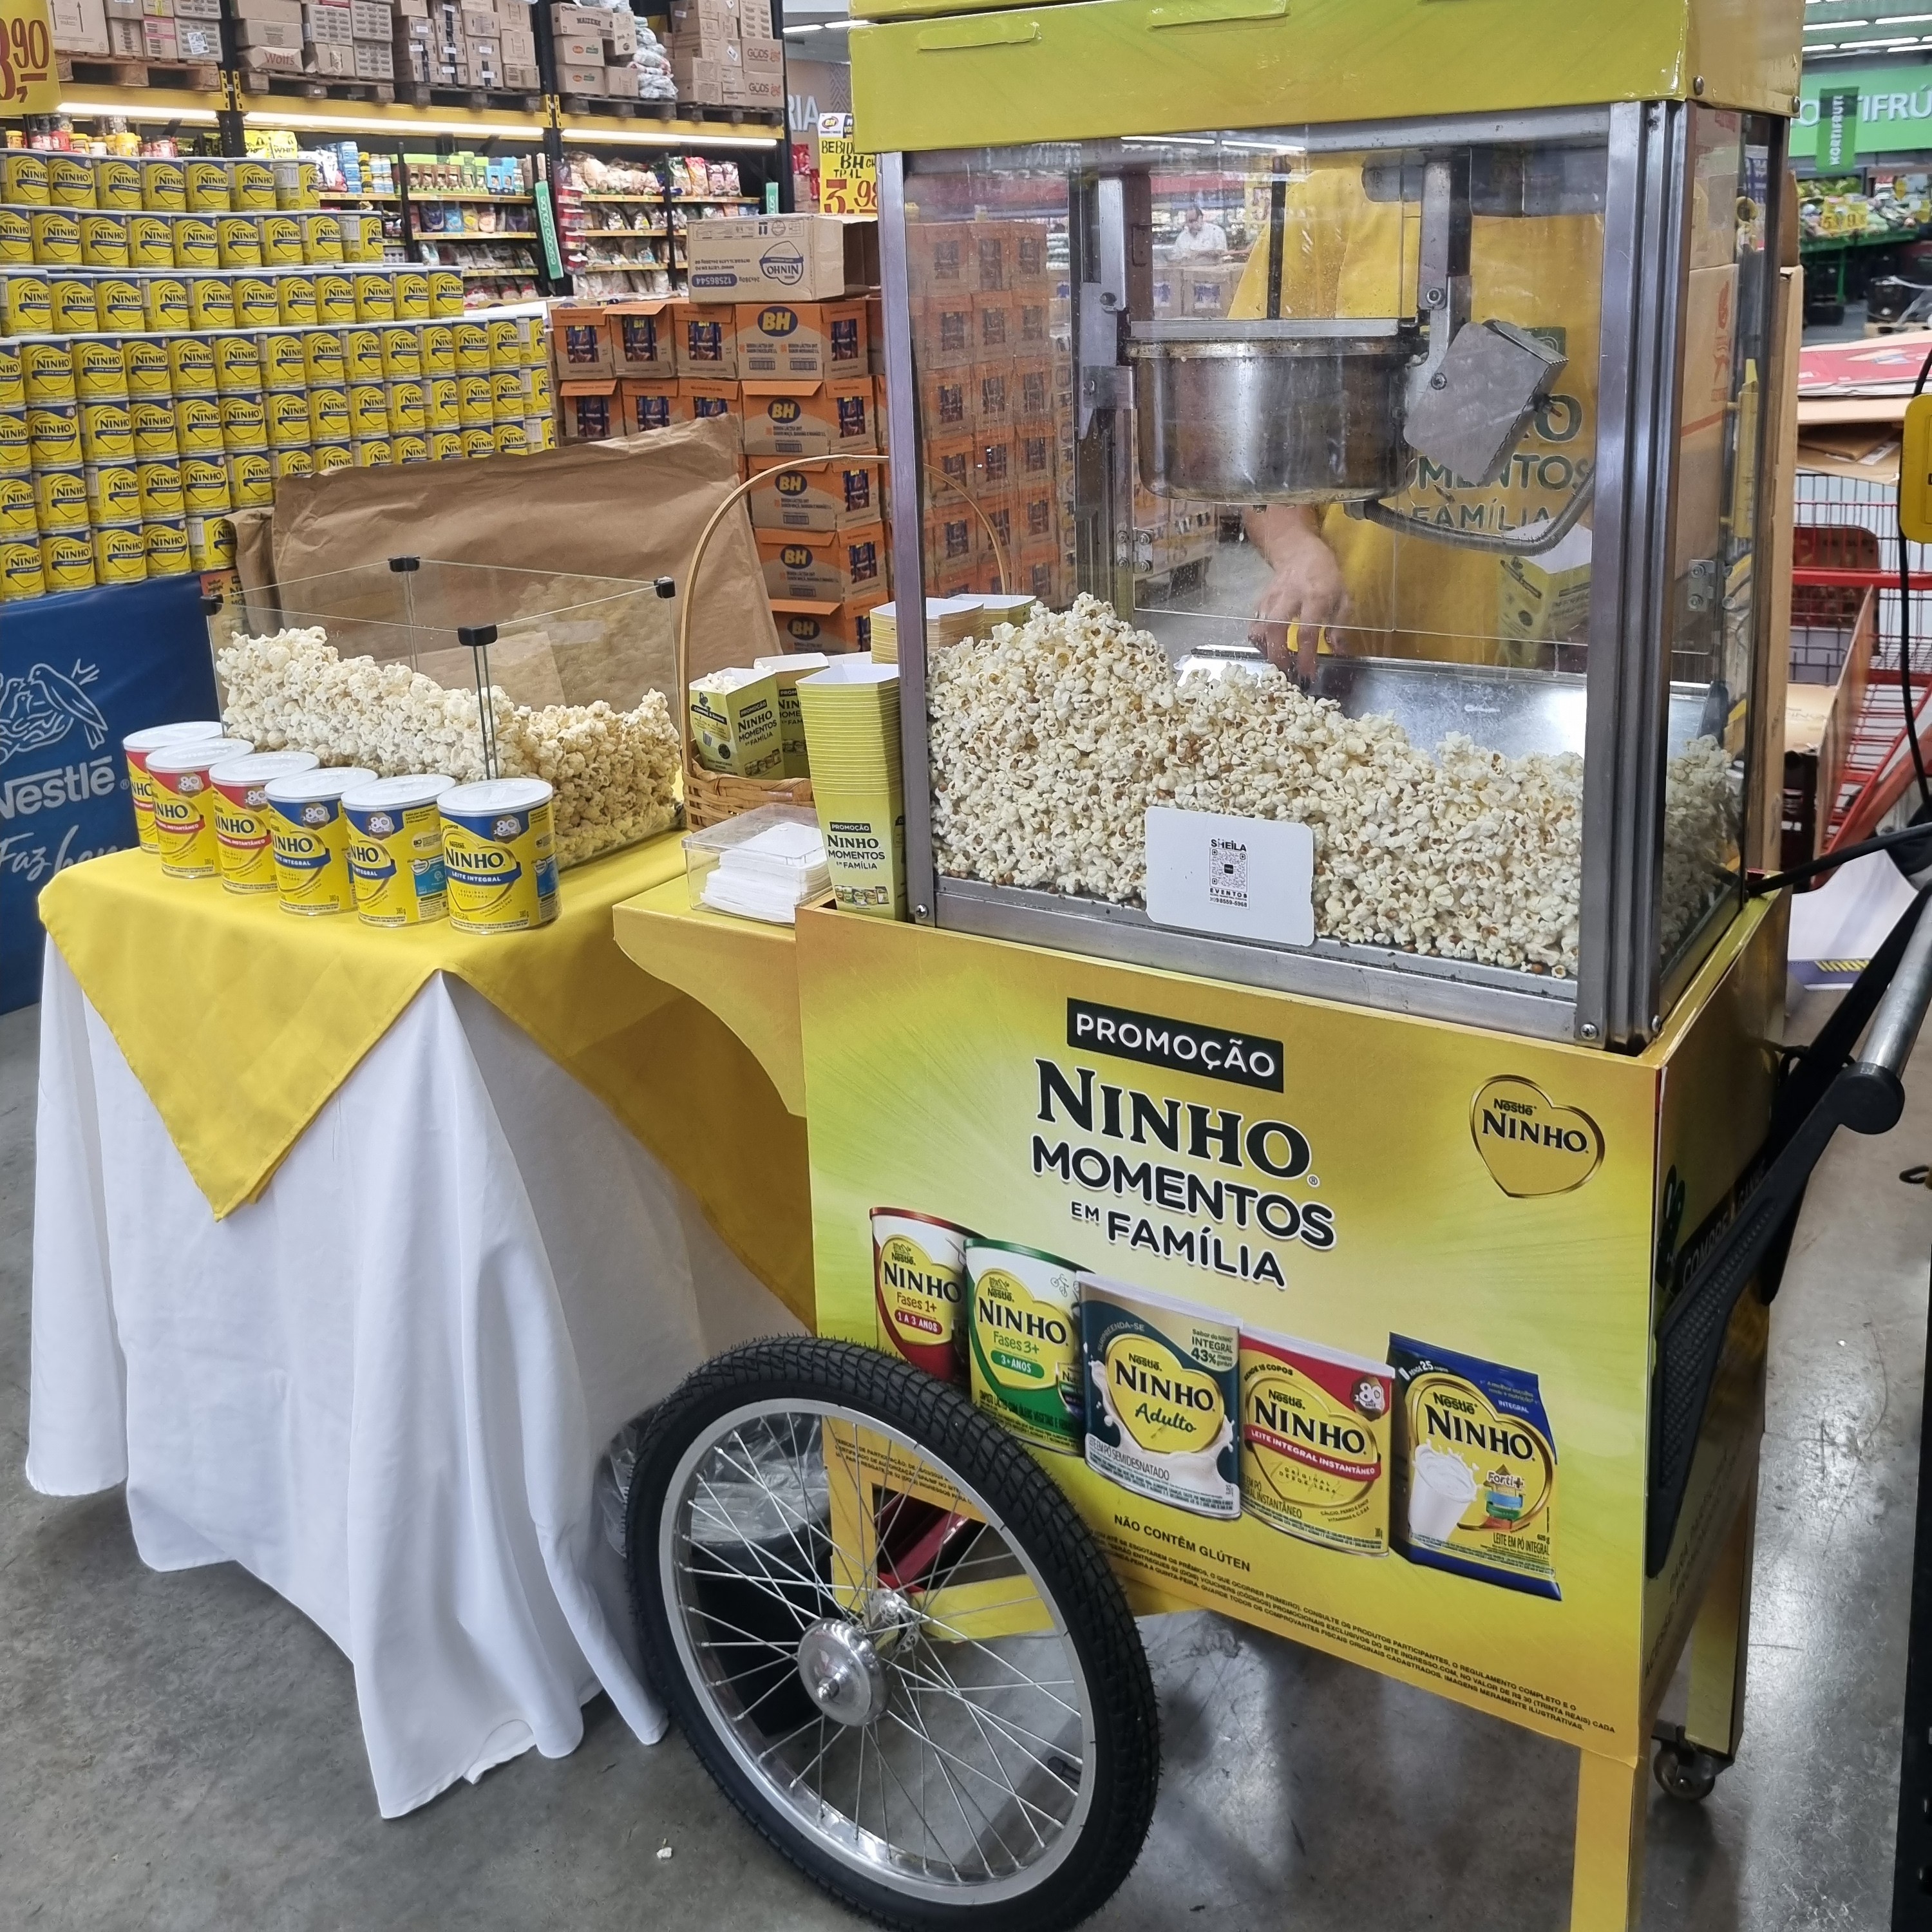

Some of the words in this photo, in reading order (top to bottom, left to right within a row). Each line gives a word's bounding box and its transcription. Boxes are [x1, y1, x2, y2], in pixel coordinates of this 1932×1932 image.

[822, 140, 855, 154] BEBID
[840, 155, 864, 169] BH
[57, 172, 89, 182] NINHO
[48, 227, 78, 236] NINHO
[95, 230, 126, 240] NINHO
[188, 231, 216, 241] NINHO
[767, 265, 799, 274] NINHO
[111, 294, 140, 303] NINHO
[247, 291, 276, 300] NINHO
[762, 312, 791, 330] BH
[463, 336, 487, 345] NINHO
[87, 357, 120, 366] NINHO
[136, 355, 166, 365] NINHO
[184, 352, 212, 362] NINHO
[229, 350, 257, 359] NINHO
[36, 359, 70, 369] NINHO
[228, 410, 260, 419] NINHO
[772, 403, 795, 418] BH
[35, 424, 71, 433] NINHO
[139, 417, 171, 426] NINHO
[151, 477, 179, 486] NINHO
[190, 473, 222, 482] NINHO
[779, 476, 801, 491] BH
[112, 543, 142, 552] NINHO
[150, 537, 184, 547] NINHO
[10, 557, 41, 567] NINHO
[56, 551, 89, 560] NINHO
[784, 549, 807, 565] BH
[793, 621, 814, 636] BH
[737, 710, 772, 732] NINHO
[739, 720, 777, 742] MOMENTOS
[750, 732, 773, 745] FAMÍLIA
[154, 802, 189, 819] INHO
[827, 835, 879, 849] NINHO
[283, 858, 311, 866] INTEGRAL
[445, 847, 504, 869] NINHO
[828, 850, 886, 860] MOMENTOS
[844, 861, 878, 869] FAMÍLIA
[452, 871, 466, 880] LEITE
[1077, 1013, 1274, 1077] PROMOÇÃO
[1493, 1098, 1533, 1115] Nestlé
[1035, 1059, 1311, 1179] NINHO
[1482, 1109, 1587, 1152] NINHO
[1032, 1136, 1334, 1247] MOMENTOS
[1072, 1202, 1099, 1222] EM
[1108, 1211, 1286, 1287] FAMÍLIA
[891, 1253, 914, 1265] Nestlé
[884, 1260, 962, 1303] NINHO
[896, 1292, 922, 1310] Fases
[925, 1301, 937, 1312] 1+
[987, 1287, 1013, 1302] Nestlé
[904, 1314, 909, 1323] A
[911, 1316, 916, 1325] 3
[918, 1318, 938, 1332] ANOS
[979, 1296, 1066, 1345] NINHO
[1097, 1321, 1145, 1352] SURPREENDA-SE
[1192, 1329, 1209, 1338] Sabor
[994, 1331, 1022, 1352] Fases
[1023, 1340, 1039, 1354] 3+
[1191, 1336, 1233, 1353] INTEGRAL
[1128, 1352, 1160, 1370] Nestlé
[1191, 1347, 1217, 1365] 43%
[1012, 1356, 1032, 1373] ANOS
[1266, 1363, 1293, 1376] COPOS
[1420, 1361, 1434, 1371] 25
[1115, 1358, 1214, 1411] NINHO
[1268, 1388, 1303, 1408] Nestlé
[1433, 1392, 1475, 1415] Nestlé
[1498, 1399, 1530, 1414] INTEGRAL
[1135, 1403, 1197, 1433] Adulto
[1254, 1395, 1365, 1454] NINHO
[1425, 1403, 1533, 1460] NINHO
[1251, 1430, 1271, 1443] LEITE
[1273, 1435, 1318, 1462] INTEGRAL
[1319, 1457, 1375, 1475] INSTANTÂNEO
[1104, 1443, 1112, 1457] PÓ
[1112, 1447, 1170, 1481] SEMIDESNATADO
[1255, 1479, 1262, 1492] PÓ
[1488, 1471, 1524, 1488] Forti+
[1256, 1488, 1302, 1519] INSTANTÂNEO
[1115, 1514, 1140, 1531] NÃO
[1144, 1525, 1196, 1552] CONTÊM
[1199, 1546, 1251, 1572] GLÚTEN
[1493, 1532, 1507, 1544] LEITE
[1508, 1535, 1516, 1548] EM
[1517, 1537, 1525, 1551] PÓ
[1525, 1540, 1549, 1555] INTEGRAL
[1201, 1584, 1229, 1599] GUARDE
[1230, 1595, 1253, 1608] TODOS
[1264, 1607, 1320, 1634] COMPROVANTES
[1321, 1629, 1348, 1643] FISCAIS
[1349, 1640, 1385, 1658] ORIGINAIS
[1444, 1674, 1479, 1692] IMAGENS
[1480, 1687, 1528, 1711] MERAMENTE
[1231, 1580, 1264, 1597] OCORRER
[1303, 1606, 1340, 1625] CONSULTE
[1352, 1624, 1392, 1644] PRODUTOS
[1460, 1664, 1517, 1690] REGULAMENTO
[1519, 1685, 1561, 1706] COMPLETO
[1200, 1576, 1236, 1594] VOUCHERS
[1273, 1604, 1325, 1628] PROMOCIONAIS
[1326, 1622, 1370, 1645] EXCLUSIVOS
[1371, 1639, 1382, 1648] DO
[1383, 1643, 1399, 1656] SITE
[1460, 1671, 1472, 1681] NO
[1473, 1676, 1498, 1692] VALOR
[1500, 1687, 1510, 1696] DE
[1533, 1698, 1563, 1716] (TRINTA
[1565, 1708, 1591, 1726] REAIS)
[1593, 1720, 1615, 1734] CADA
